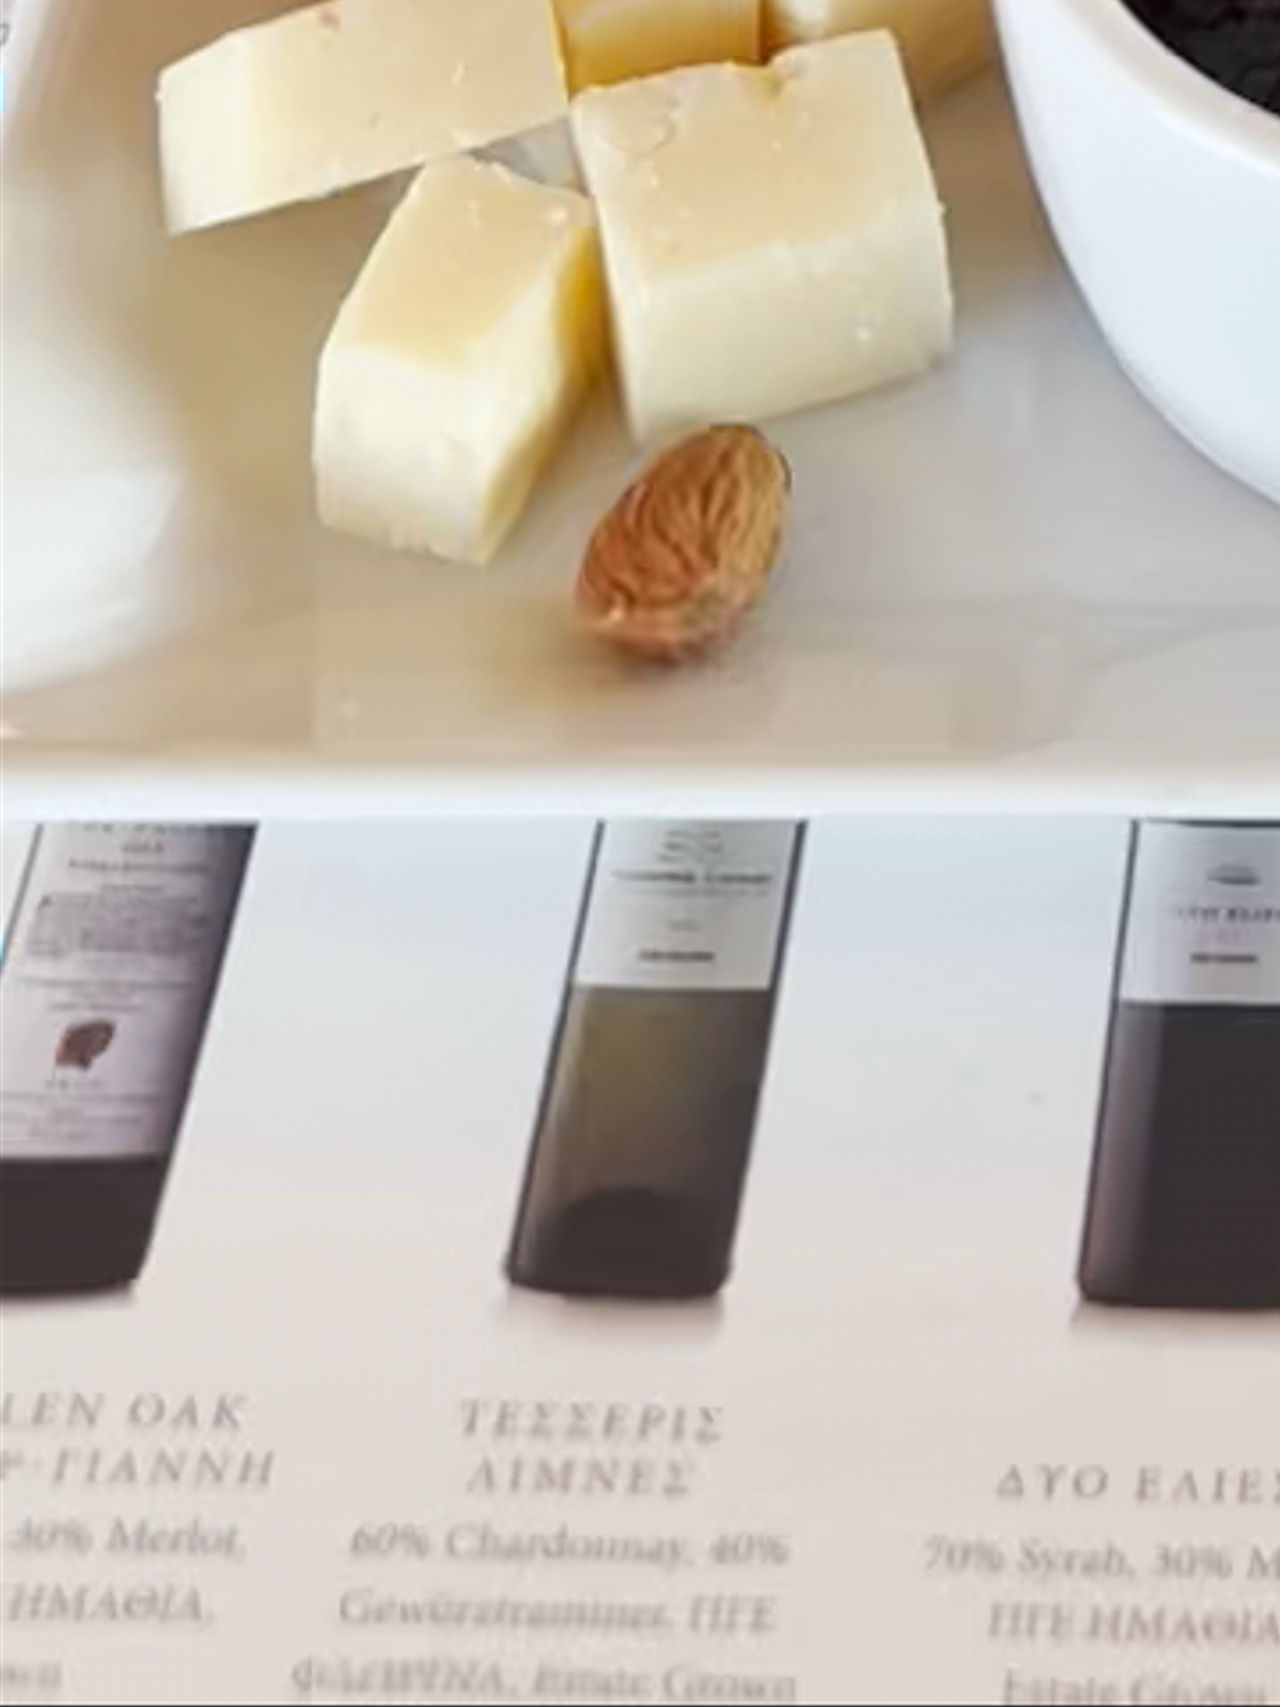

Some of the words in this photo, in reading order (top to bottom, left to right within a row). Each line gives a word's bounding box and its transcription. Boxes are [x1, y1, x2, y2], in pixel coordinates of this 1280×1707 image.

[0, 1392, 104, 1426] LEN
[128, 1392, 247, 1429] OAK
[458, 1398, 725, 1447] ΤΕΣΣΕΡΙΣ
[466, 1455, 696, 1500] ΛΙΜΝΕΣ
[995, 1463, 1109, 1505] ΔΥΟ
[106, 1517, 247, 1563] Merlot,
[350, 1521, 431, 1560] 60%
[445, 1523, 696, 1570] Chardonnay,
[923, 1535, 1005, 1576] 70%
[1015, 1536, 1138, 1587] Syrah,
[8, 1584, 215, 1627] ΗΜΑΘΙΑ,
[986, 1601, 1075, 1644] ΠΓΕ
